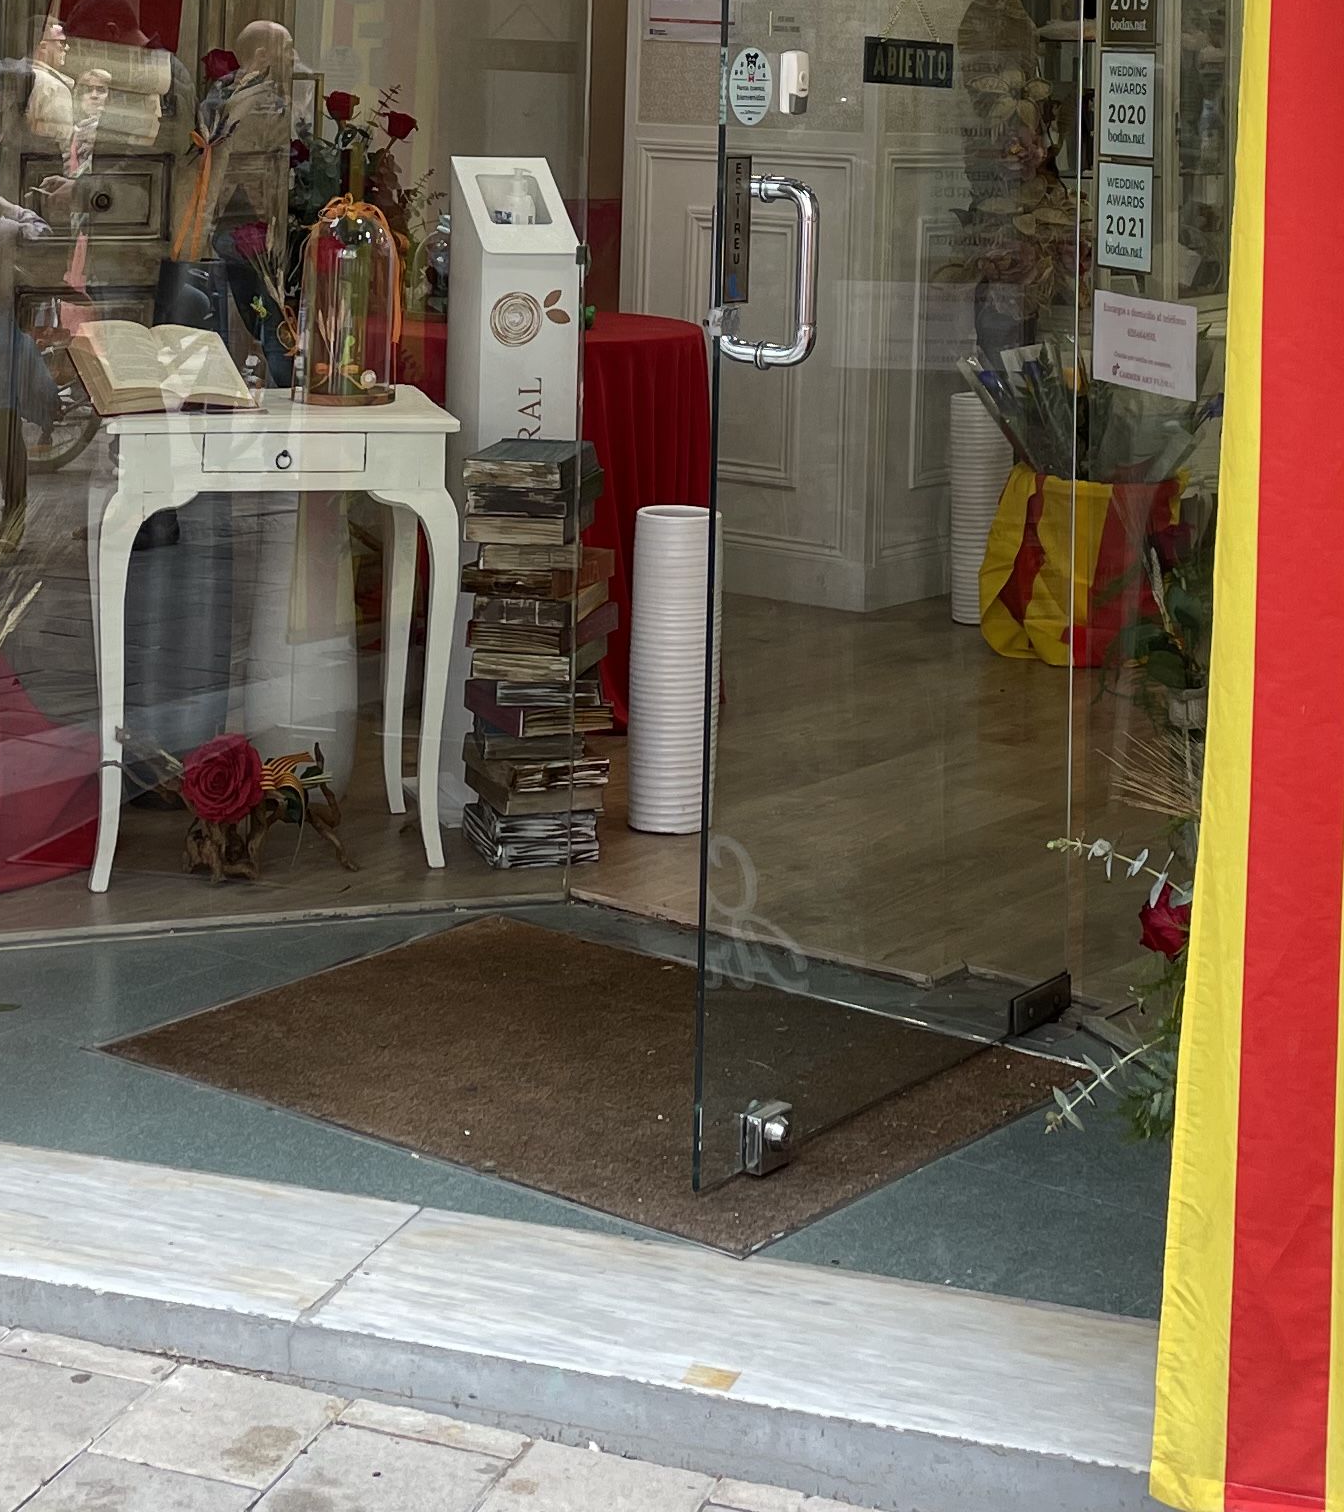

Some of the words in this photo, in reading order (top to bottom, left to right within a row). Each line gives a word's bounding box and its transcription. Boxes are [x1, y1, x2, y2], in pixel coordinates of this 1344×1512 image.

[1110, 16, 1146, 31] bodas.net
[873, 45, 947, 80] ABIERTO
[1109, 66, 1147, 78] WEDDING
[1109, 82, 1147, 96] AWARDS
[1108, 104, 1146, 125] 2020
[1107, 128, 1145, 144] bodas.net
[1107, 177, 1145, 190] WEDDING
[1106, 193, 1144, 209] AWARDS
[733, 162, 742, 265] ESTIREU
[1106, 214, 1144, 238] 2021
[1105, 240, 1143, 259] bodas.net
